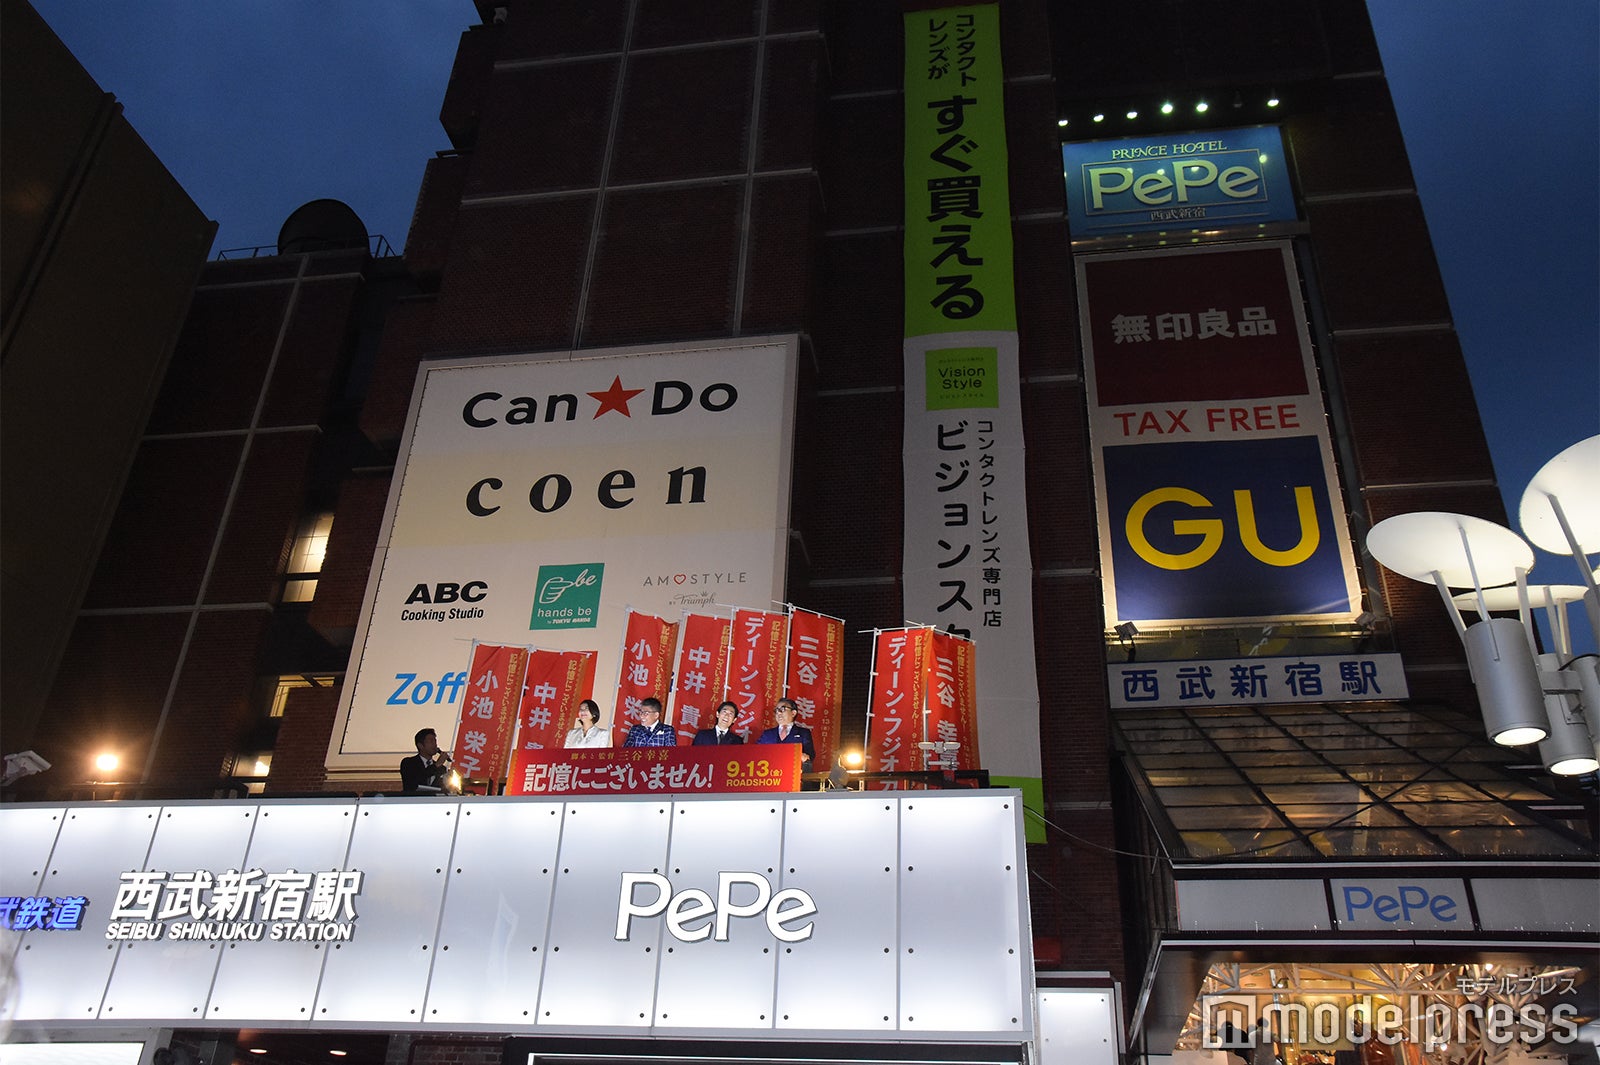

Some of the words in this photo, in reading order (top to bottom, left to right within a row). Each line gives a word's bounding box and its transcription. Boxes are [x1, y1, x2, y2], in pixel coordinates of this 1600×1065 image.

[928, 18, 950, 80] レンズが
[956, 14, 977, 87] コンタクト
[1112, 145, 1167, 160] PRINCE
[1173, 140, 1227, 154] HOTEL
[1088, 159, 1260, 209] PePe
[926, 95, 985, 320] すぐ買える
[1111, 306, 1278, 344] 無印良品
[938, 366, 985, 378] Vision
[943, 378, 982, 390] Style
[1114, 409, 1192, 437] TAX
[1207, 404, 1300, 433] FREE
[466, 465, 707, 518] coen
[977, 420, 1002, 628] コンタクトレンズ専門店
[1125, 486, 1321, 571] GU
[404, 581, 488, 605] ABC
[401, 609, 445, 623] Cooking
[448, 607, 484, 620] Studio
[537, 608, 573, 618] hands
[578, 607, 592, 617] be
[386, 671, 468, 706] Zoff
[1121, 660, 1382, 702] 西武新宿駅
[523, 762, 713, 792] 記憶にございません!
[726, 778, 782, 787] ROADSHOW
[110, 868, 363, 922] 西武新宿駅
[614, 871, 818, 942] PePe
[1342, 885, 1458, 922] PePe
[105, 922, 162, 941] SEIBU
[168, 922, 263, 941] SHINJUKU
[270, 922, 354, 941] STATION
